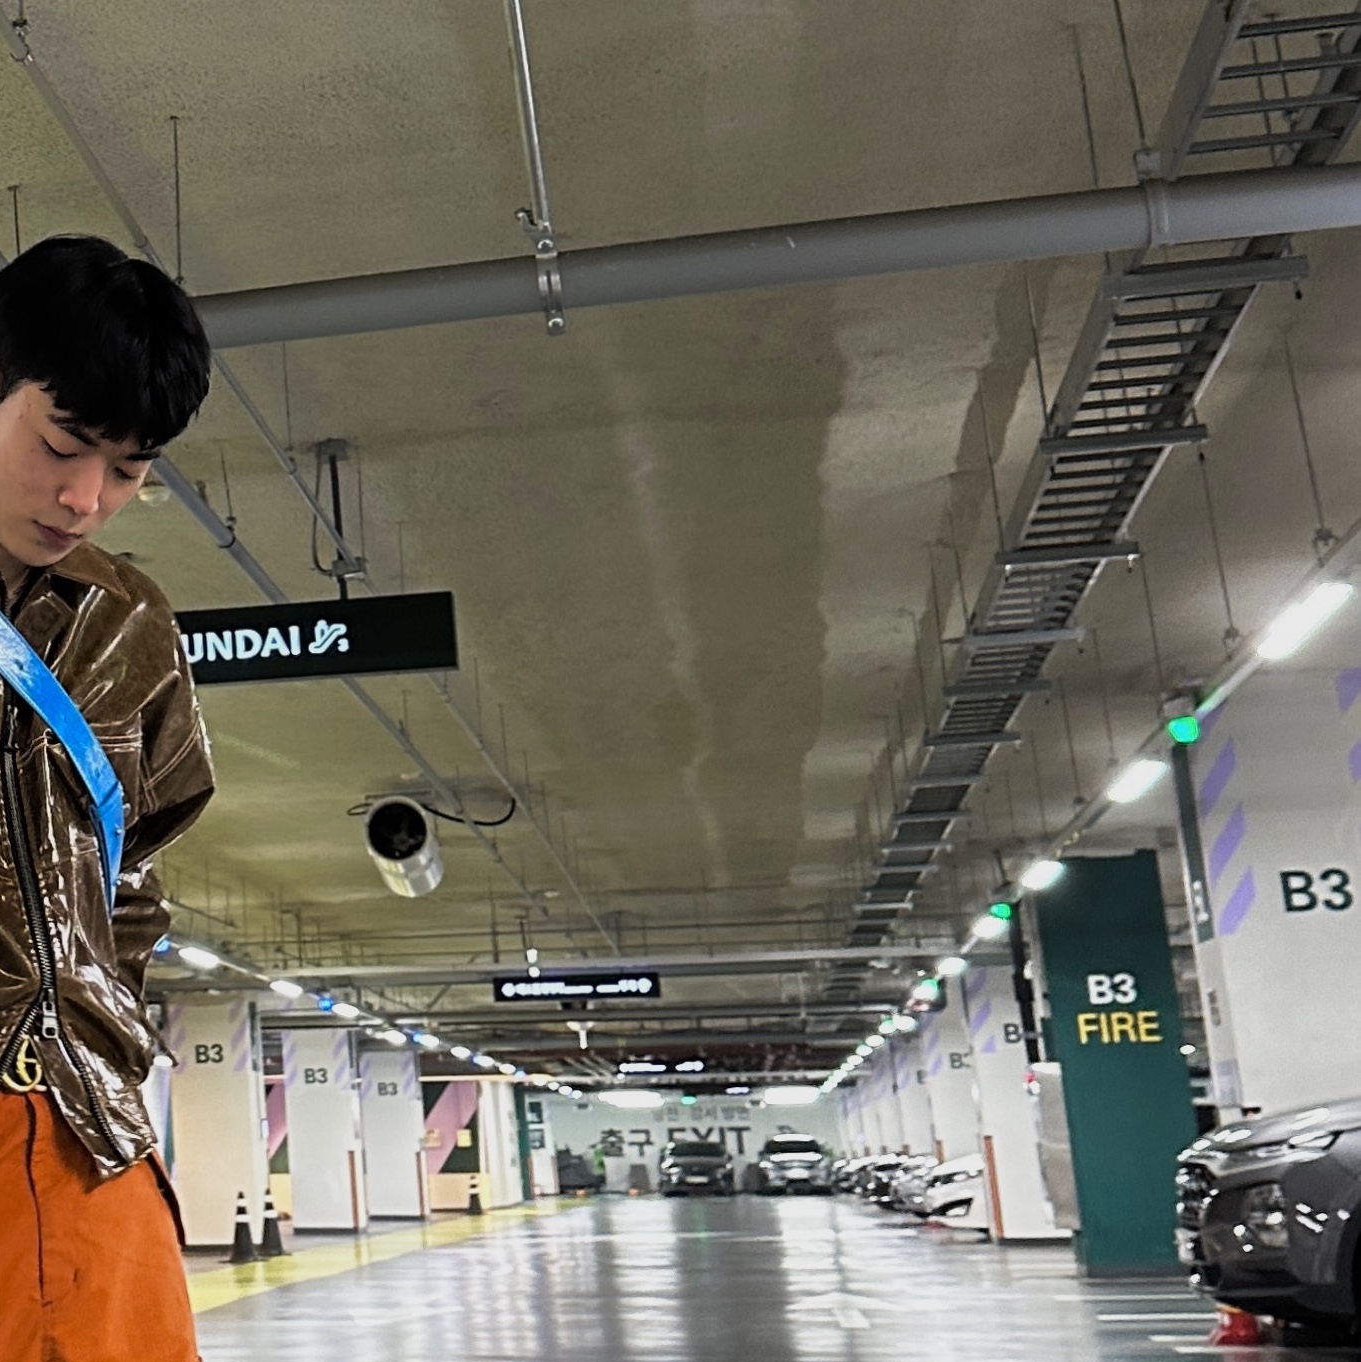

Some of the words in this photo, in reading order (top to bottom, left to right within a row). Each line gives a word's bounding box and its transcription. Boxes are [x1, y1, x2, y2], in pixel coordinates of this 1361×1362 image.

[181, 625, 302, 664] UNDAI
[1279, 867, 1354, 913] B3
[1087, 973, 1138, 1005] B3
[1077, 1010, 1164, 1045] FIRE
[195, 1044, 224, 1064] B3
[304, 1068, 329, 1084] B3
[377, 1082, 399, 1096] B3
[601, 1128, 654, 1157] 출구
